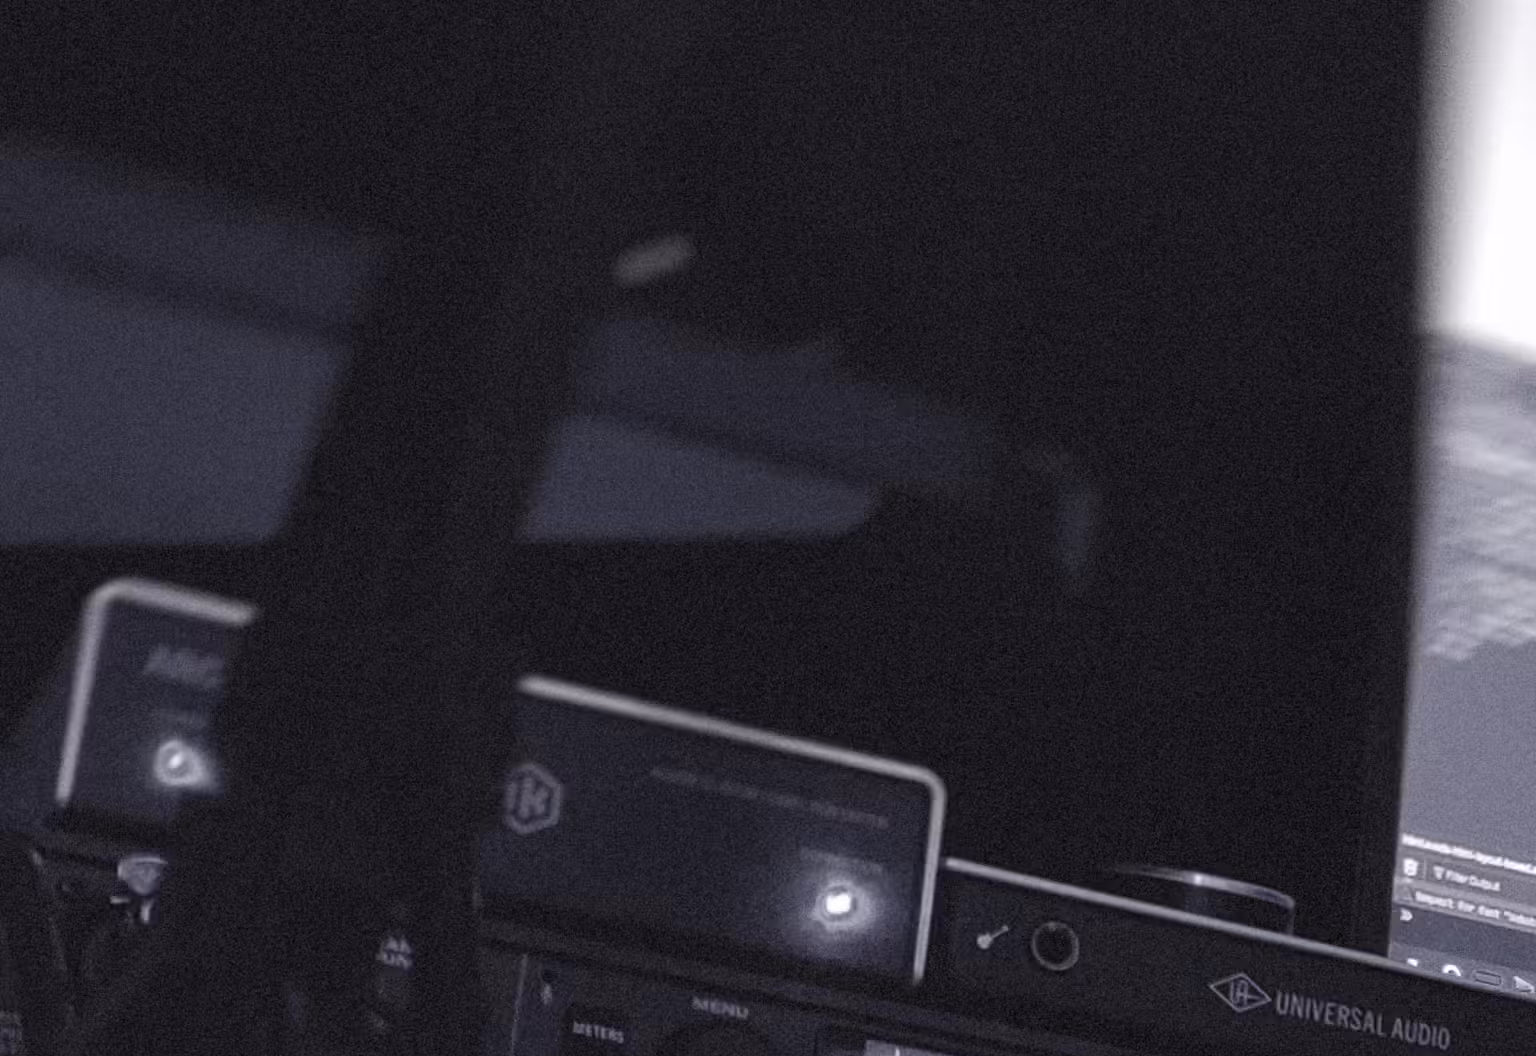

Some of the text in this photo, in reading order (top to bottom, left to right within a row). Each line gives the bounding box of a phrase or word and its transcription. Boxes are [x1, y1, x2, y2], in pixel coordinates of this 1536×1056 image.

[692, 996, 750, 1020] MENU
[572, 1020, 625, 1044] METERS
[1275, 990, 1451, 1051] UNIVERSAL AUDIO
